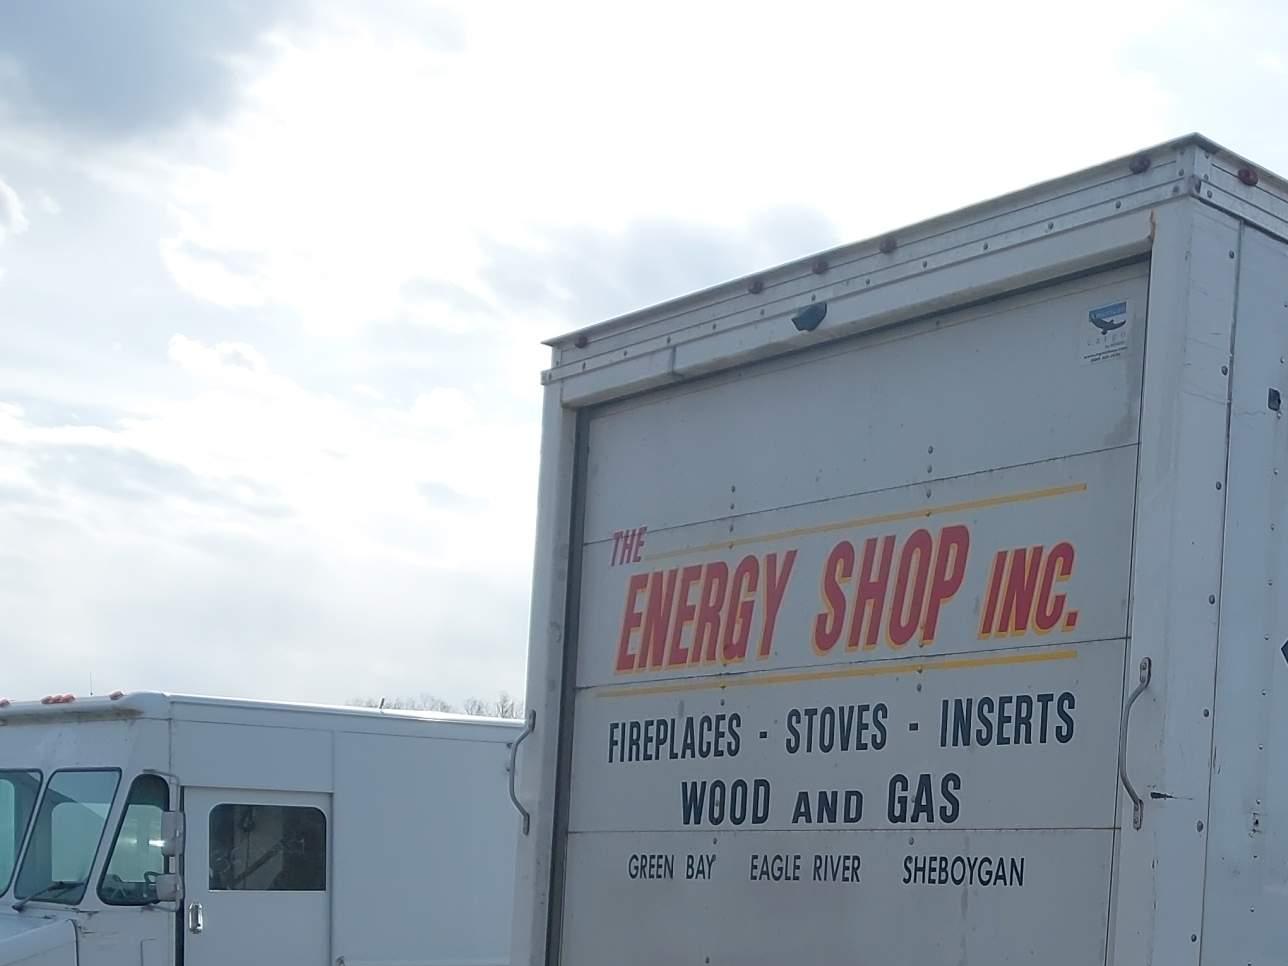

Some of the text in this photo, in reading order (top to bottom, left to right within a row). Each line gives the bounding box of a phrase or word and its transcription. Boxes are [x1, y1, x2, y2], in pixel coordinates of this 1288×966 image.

[610, 526, 648, 567] THE
[614, 524, 1079, 674] ENERGY SHOP INC.
[608, 712, 742, 763] FIREPLACES
[785, 703, 888, 754] STOVES
[940, 692, 1076, 747] INSERTS
[681, 773, 961, 825] WOOD AND GAS
[628, 854, 1025, 888] GREEN BAY EAGLE RIVER SHEBOYGAN
